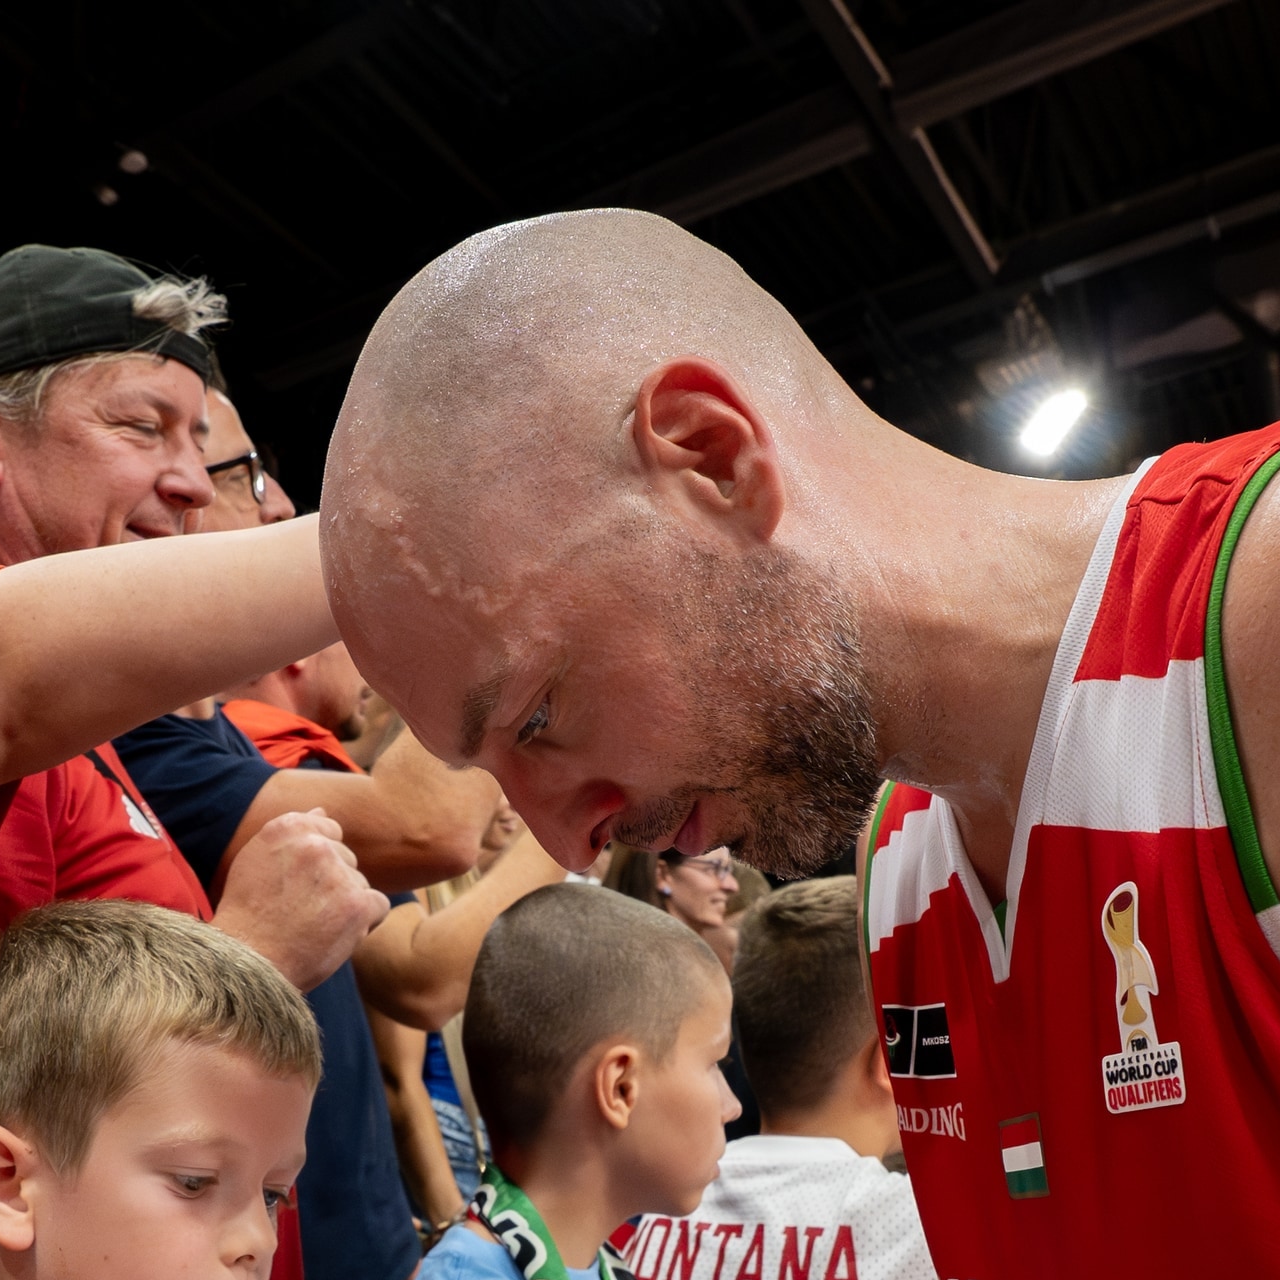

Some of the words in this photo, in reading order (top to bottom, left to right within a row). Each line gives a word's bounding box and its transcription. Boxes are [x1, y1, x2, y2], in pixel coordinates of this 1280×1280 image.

[922, 1035, 949, 1046] MKOSZ
[1106, 1048, 1175, 1069] BASKETBALL
[1106, 1063, 1152, 1085] WORLD
[1154, 1058, 1178, 1077] CUP
[1108, 1076, 1182, 1110] QUALIFIERS
[897, 1102, 966, 1141] ALDING
